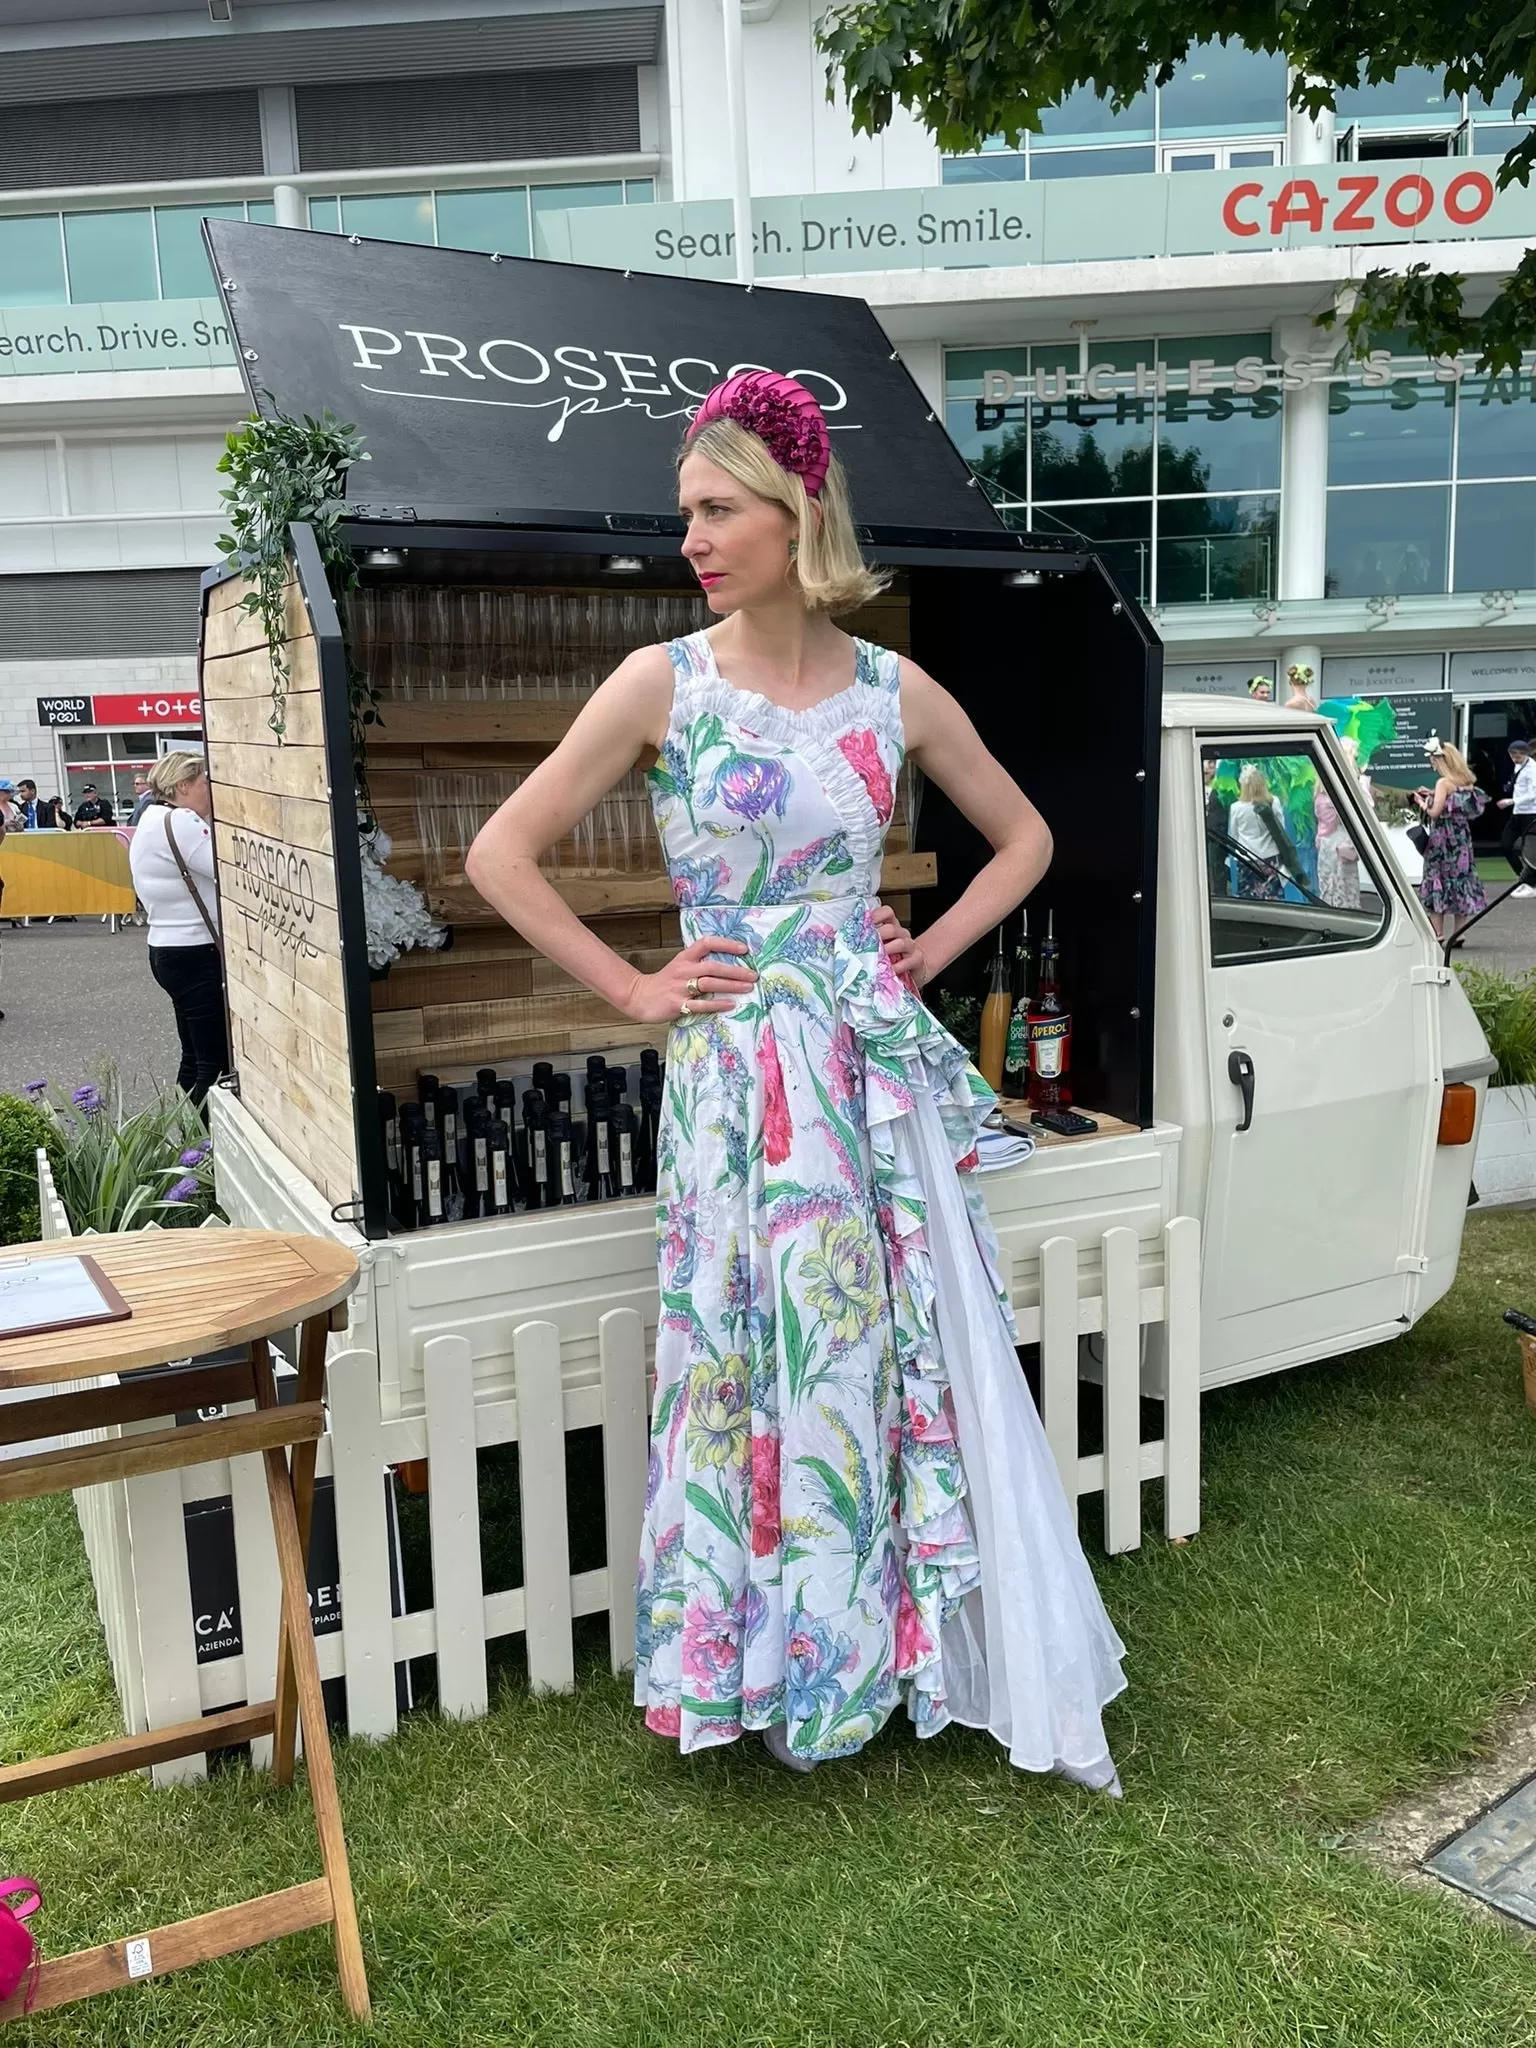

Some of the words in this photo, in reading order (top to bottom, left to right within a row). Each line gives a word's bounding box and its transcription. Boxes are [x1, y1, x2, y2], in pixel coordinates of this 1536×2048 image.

[1222, 170, 1495, 237] CAZOO
[802, 216, 906, 252] Drive.
[917, 207, 1033, 246] Smile.
[97, 322, 187, 351] Drive.
[42, 699, 86, 711] WORLD
[49, 711, 81, 724] POOL
[231, 829, 315, 924] PROSECCO
[1032, 1023, 1067, 1038] APEROL
[195, 1606, 234, 1635] CA'
[198, 1636, 241, 1653] AZIENDA
[311, 1611, 342, 1625] PIADE
